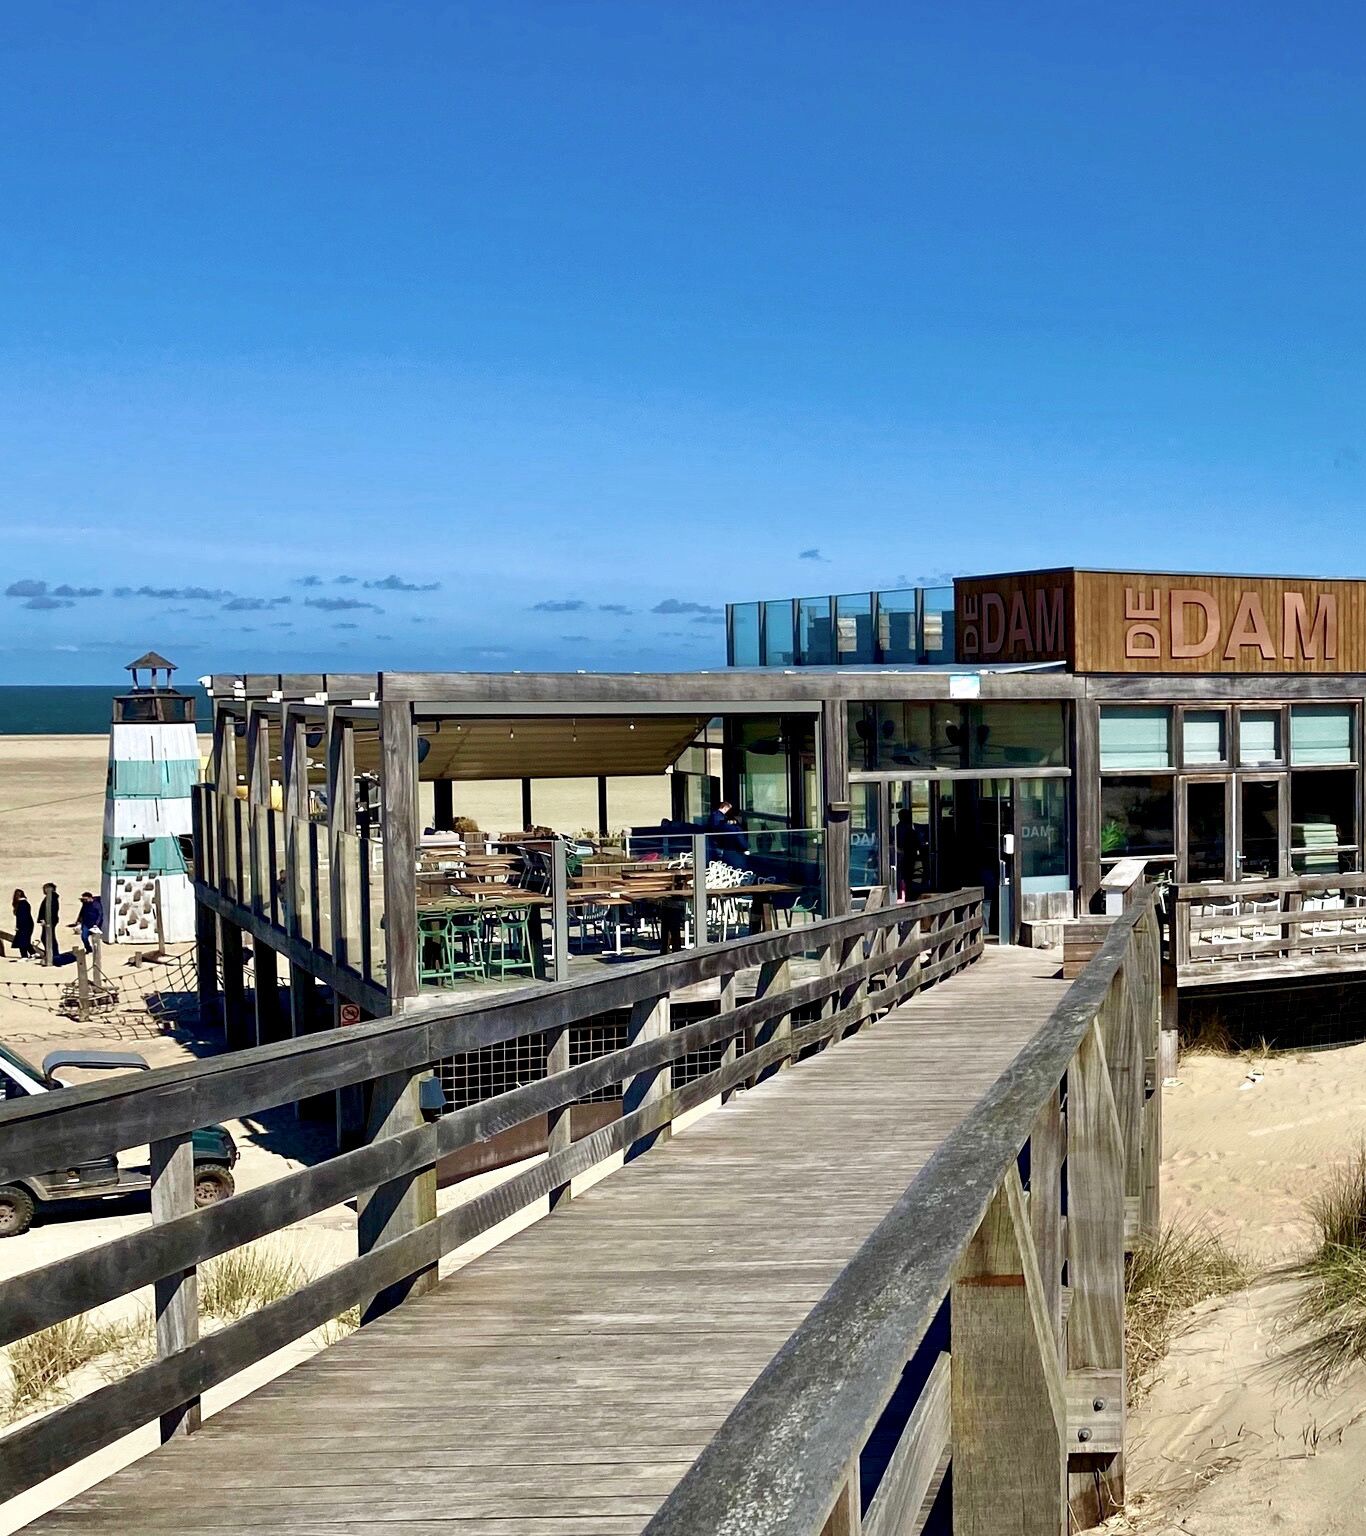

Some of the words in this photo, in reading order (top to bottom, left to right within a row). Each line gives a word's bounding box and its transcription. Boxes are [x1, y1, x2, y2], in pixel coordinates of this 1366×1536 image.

[963, 594, 979, 654] DE
[982, 587, 1064, 654] DAM
[1125, 587, 1161, 658] DE
[1169, 589, 1337, 660] DAM
